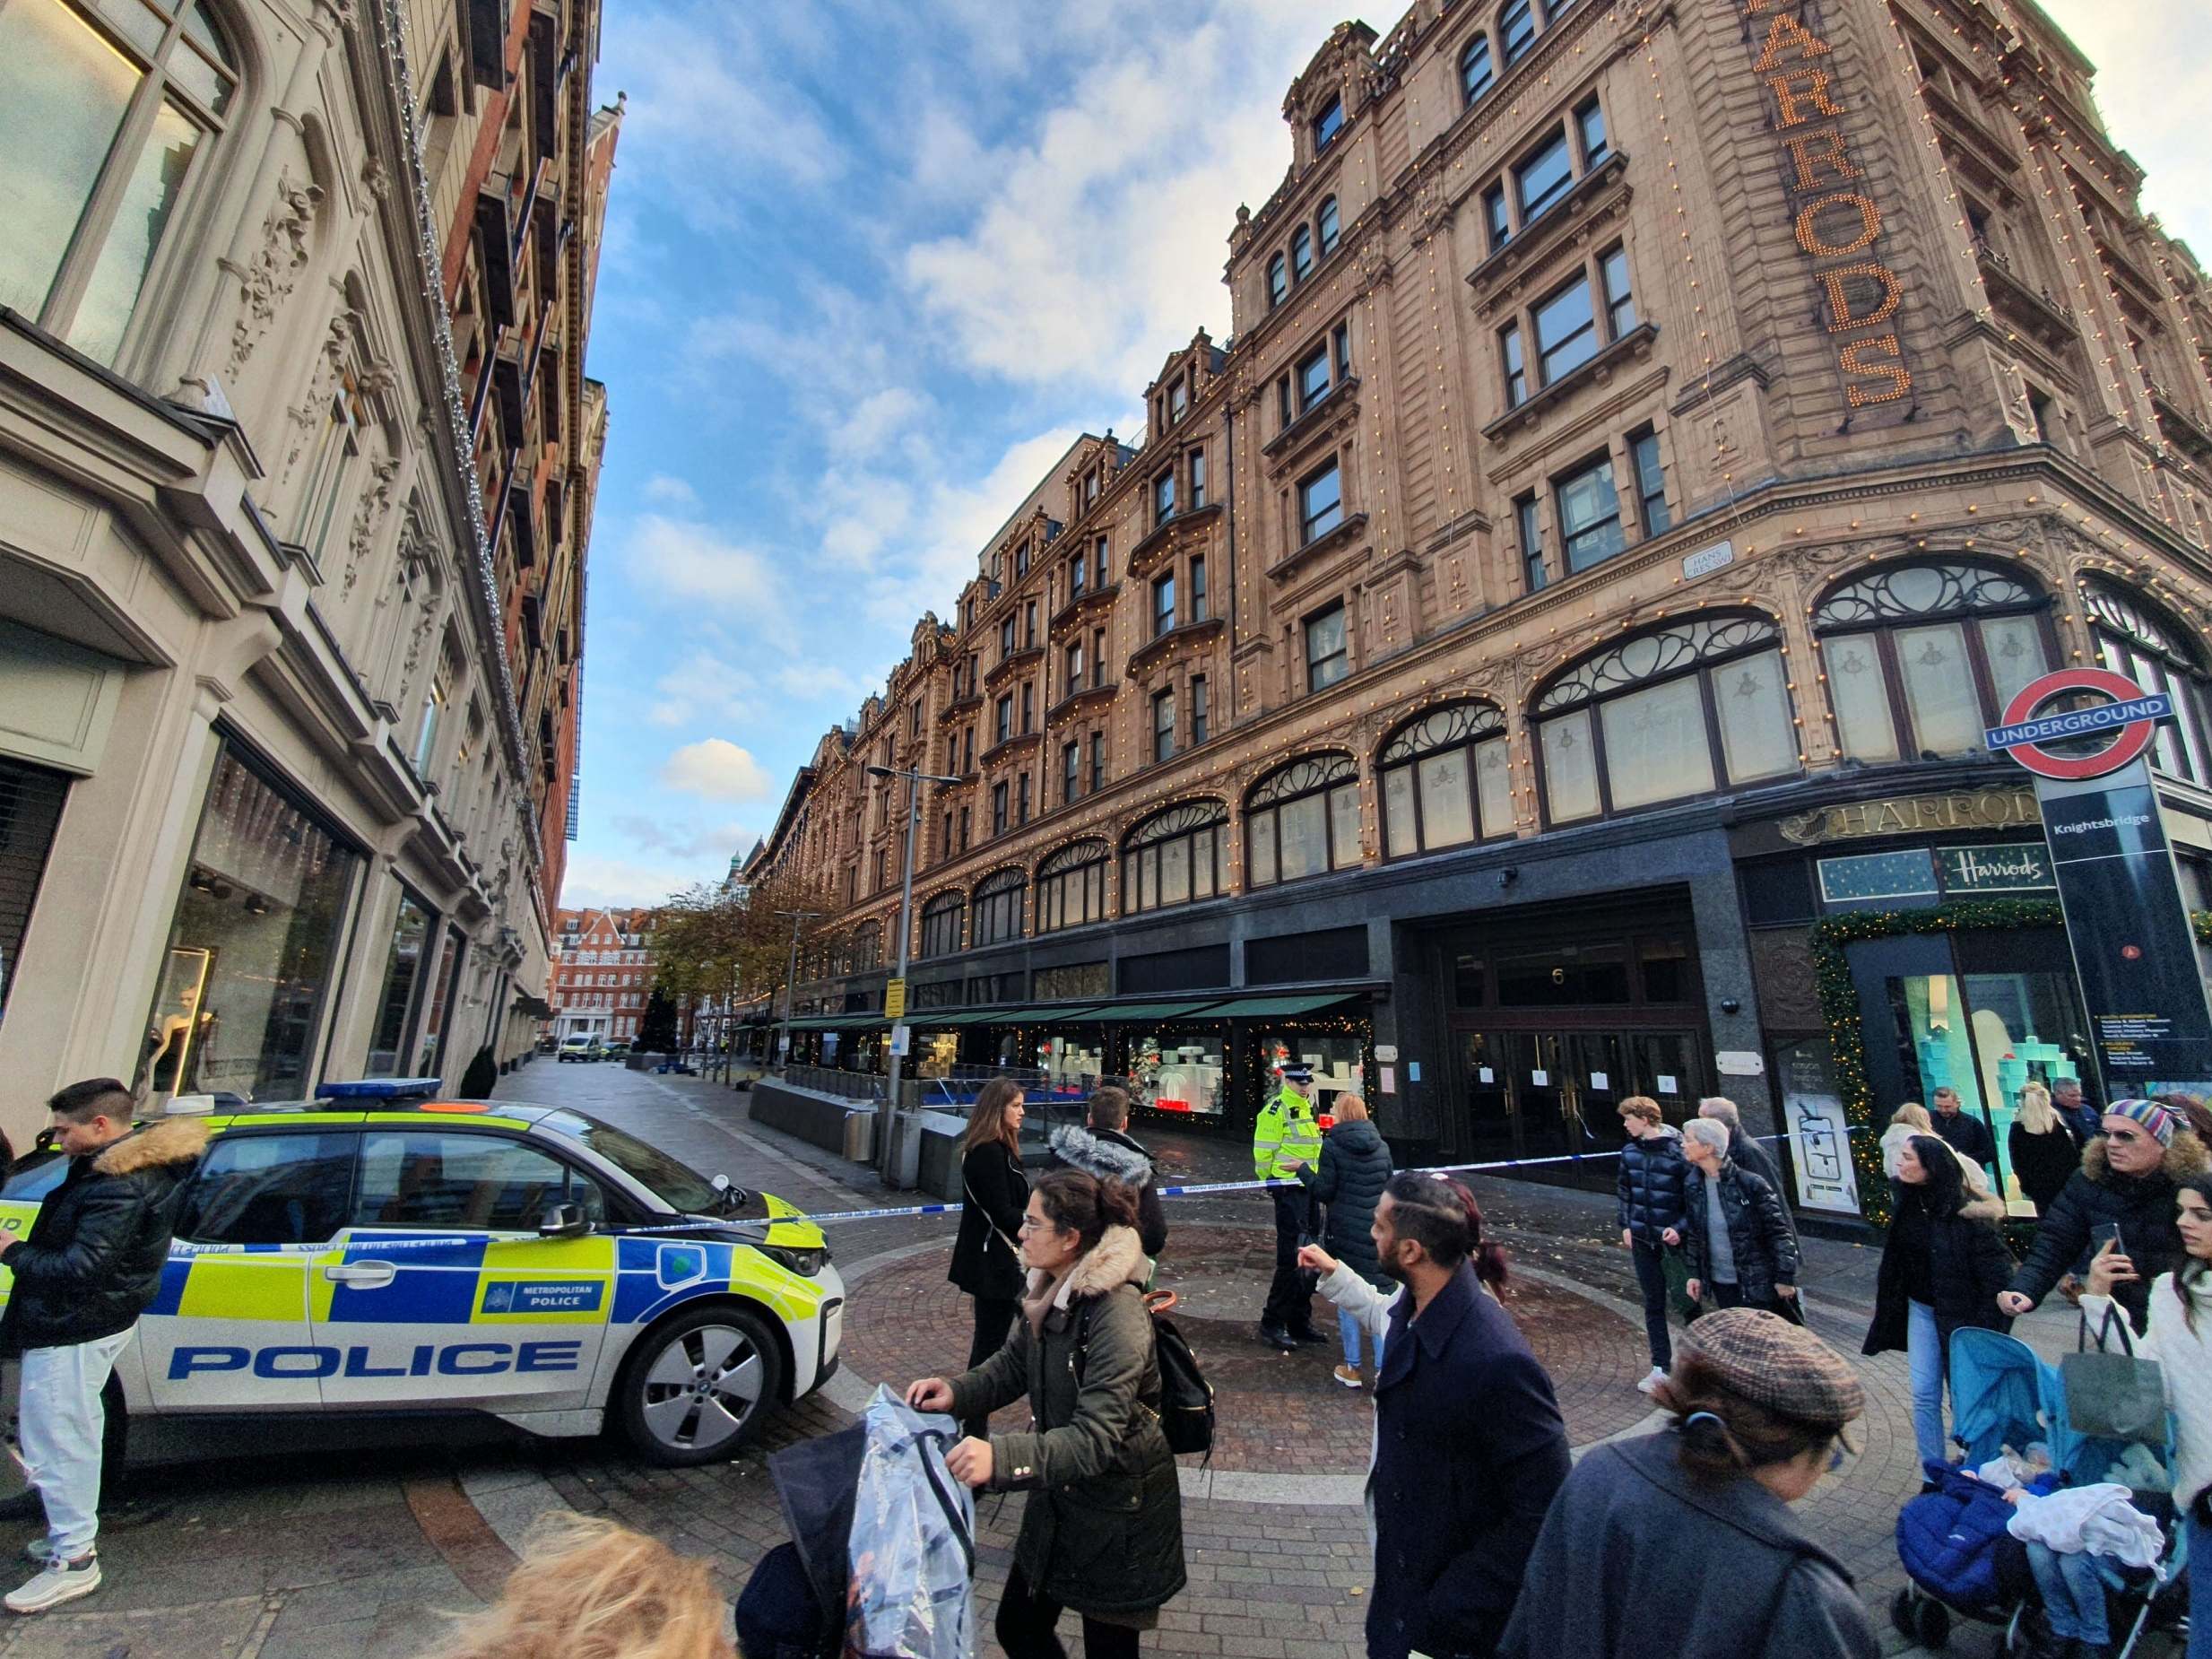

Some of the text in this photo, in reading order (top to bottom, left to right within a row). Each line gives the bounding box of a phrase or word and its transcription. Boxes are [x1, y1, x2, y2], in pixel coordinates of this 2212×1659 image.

[1743, 0, 1912, 408] ARRODS
[1693, 549, 1722, 568] HANS
[1991, 699, 2164, 745] UNDERGROUND
[1837, 791, 2041, 836] HARROD
[2053, 813, 2150, 835] Knightsbridge
[1951, 849, 2044, 882] Harrods
[523, 1286, 593, 1295] METROPOLITAN
[530, 1297, 581, 1306] POLICE
[168, 1340, 583, 1380] POLICE
